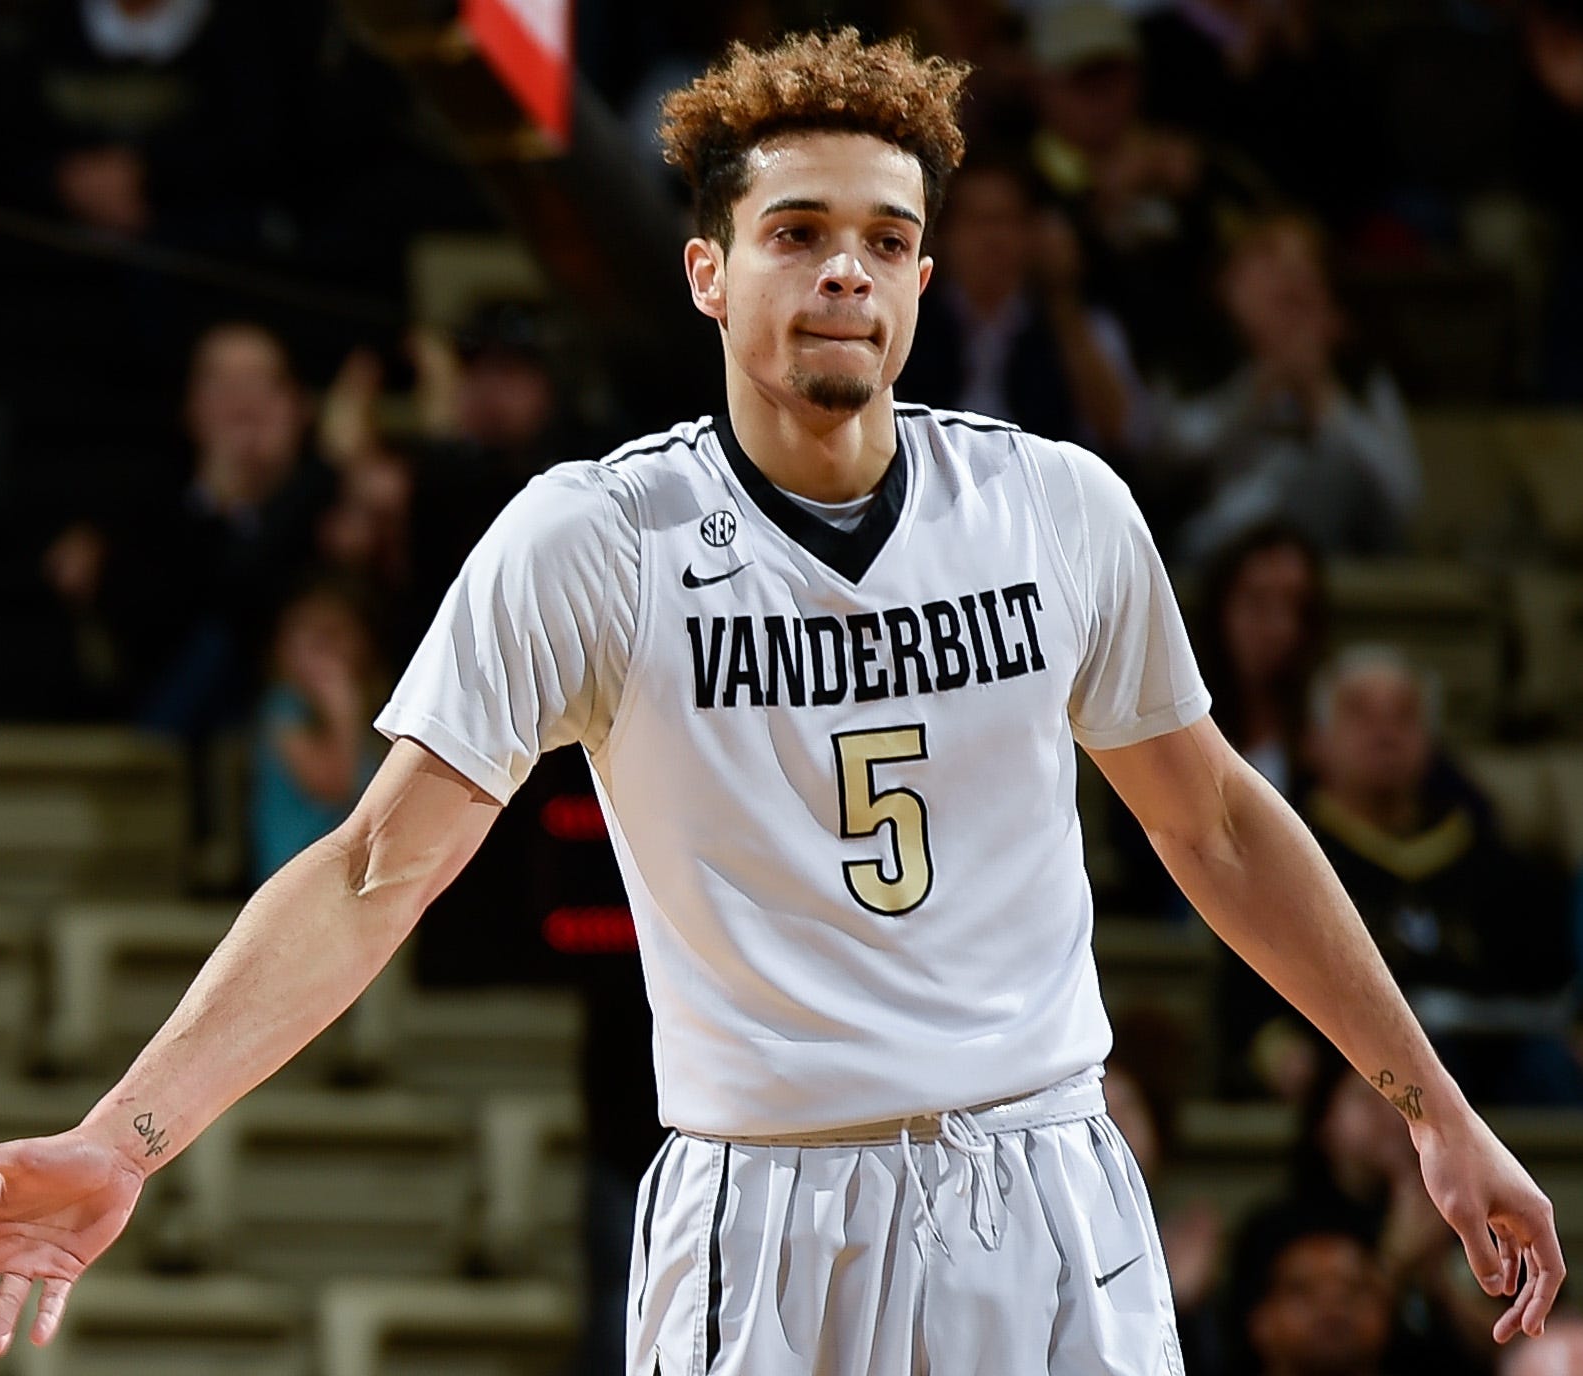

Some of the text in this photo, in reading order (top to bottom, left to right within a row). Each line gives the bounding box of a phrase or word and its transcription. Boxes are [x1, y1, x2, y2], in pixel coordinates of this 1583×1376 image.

[702, 512, 735, 545] SEC
[686, 583, 1047, 709] VANDERBILT
[831, 723, 933, 916] 5
